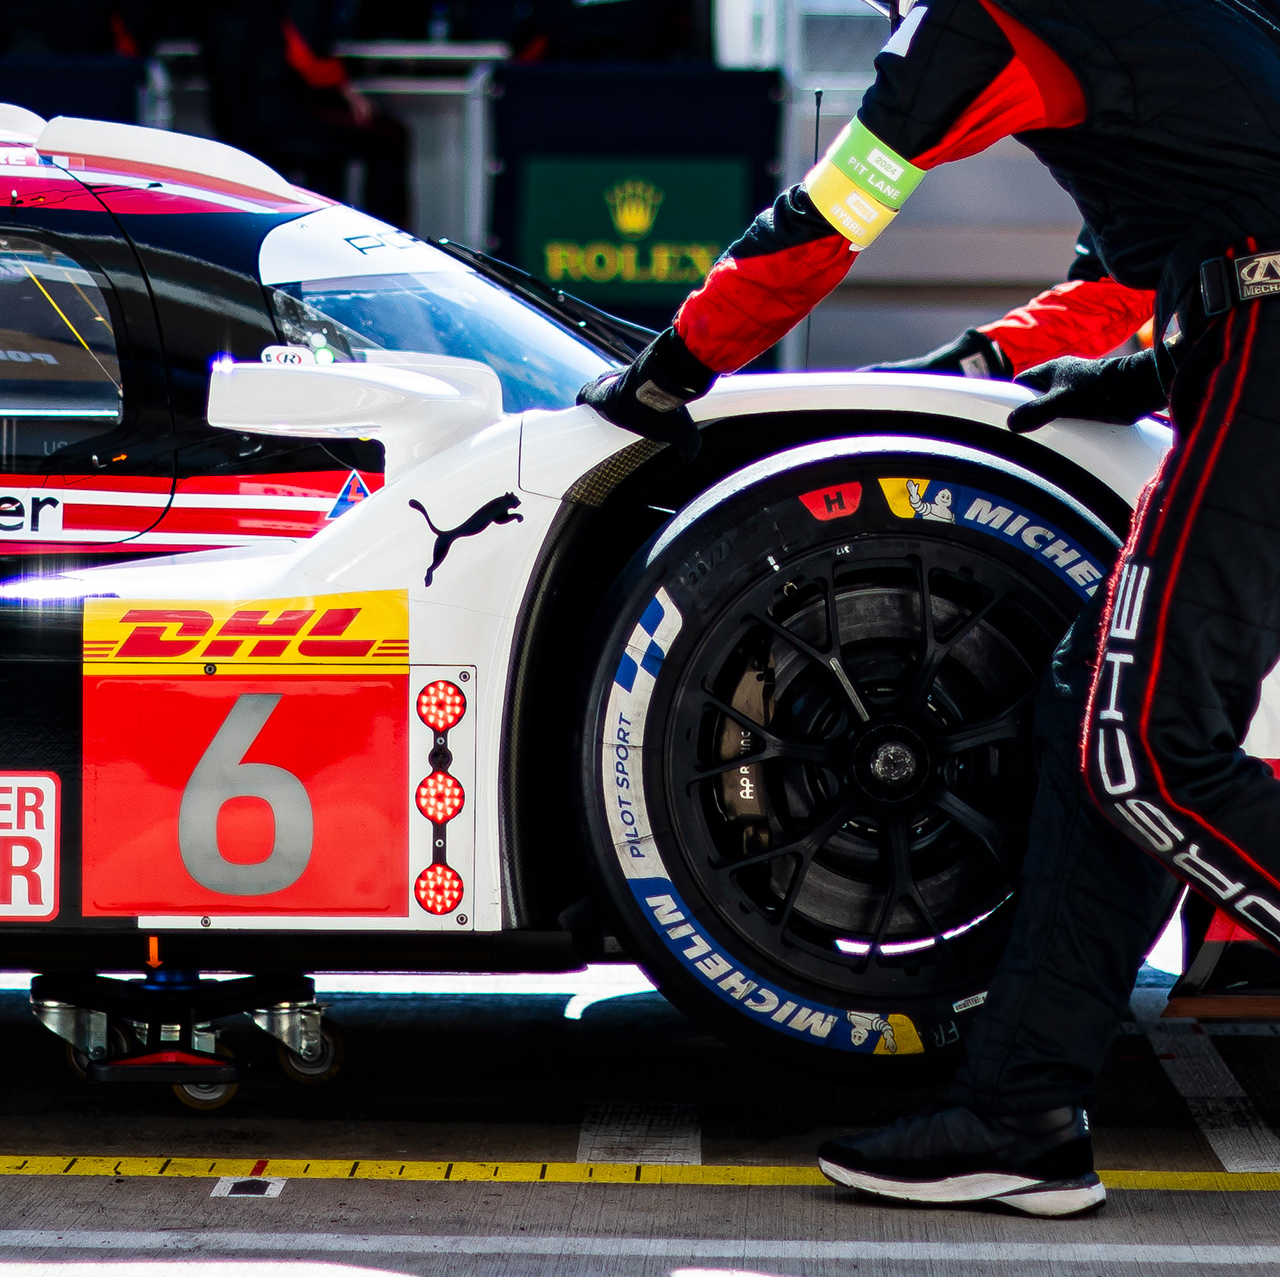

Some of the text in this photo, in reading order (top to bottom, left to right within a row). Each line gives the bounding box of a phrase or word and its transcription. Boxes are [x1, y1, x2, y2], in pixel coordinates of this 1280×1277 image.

[847, 156, 901, 200] PIT LANE
[874, 156, 898, 176] 2024
[963, 497, 1104, 597] MICHE
[115, 607, 370, 657] DHL
[177, 693, 315, 897] 6
[616, 711, 646, 859] PILOT SPORT
[644, 893, 839, 1039] MICHELIN
